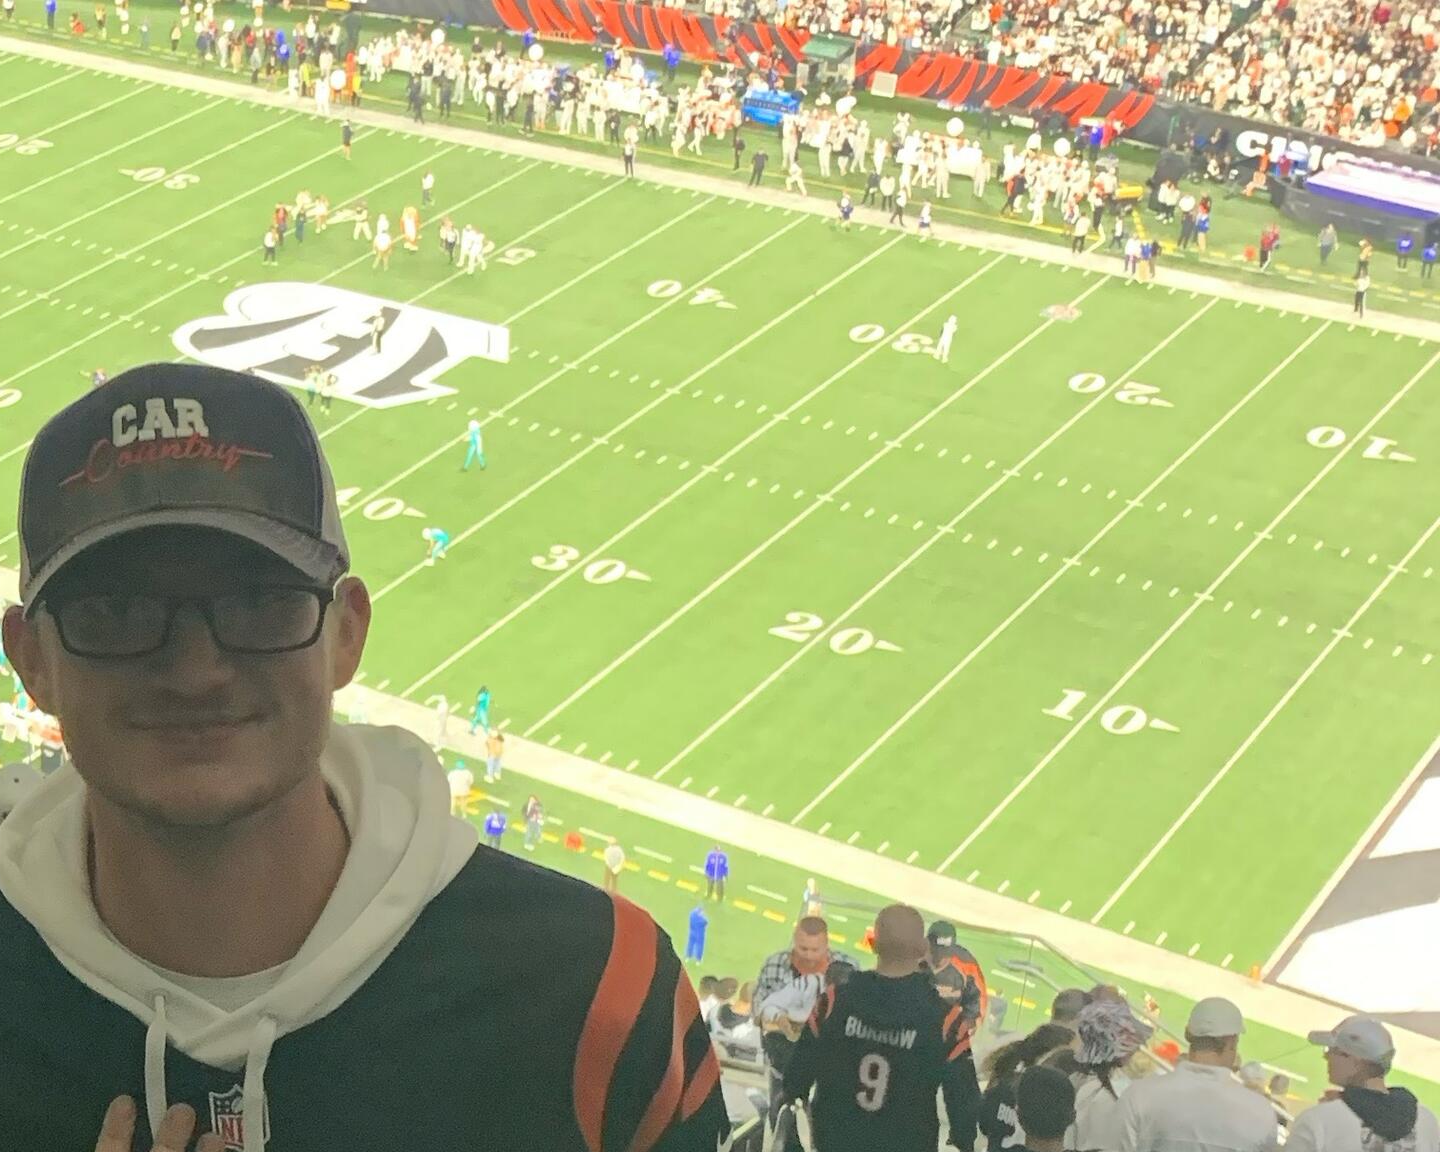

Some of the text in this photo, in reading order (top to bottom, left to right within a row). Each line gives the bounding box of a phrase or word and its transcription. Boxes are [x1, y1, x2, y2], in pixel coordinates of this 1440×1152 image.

[1067, 372, 1162, 406] 20
[113, 398, 209, 447] CAR
[1305, 425, 1399, 460] 10
[60, 432, 273, 484] Country
[530, 543, 627, 585] 30
[767, 611, 875, 656] 20
[1041, 688, 1149, 736] 10
[856, 1054, 890, 1112] 9
